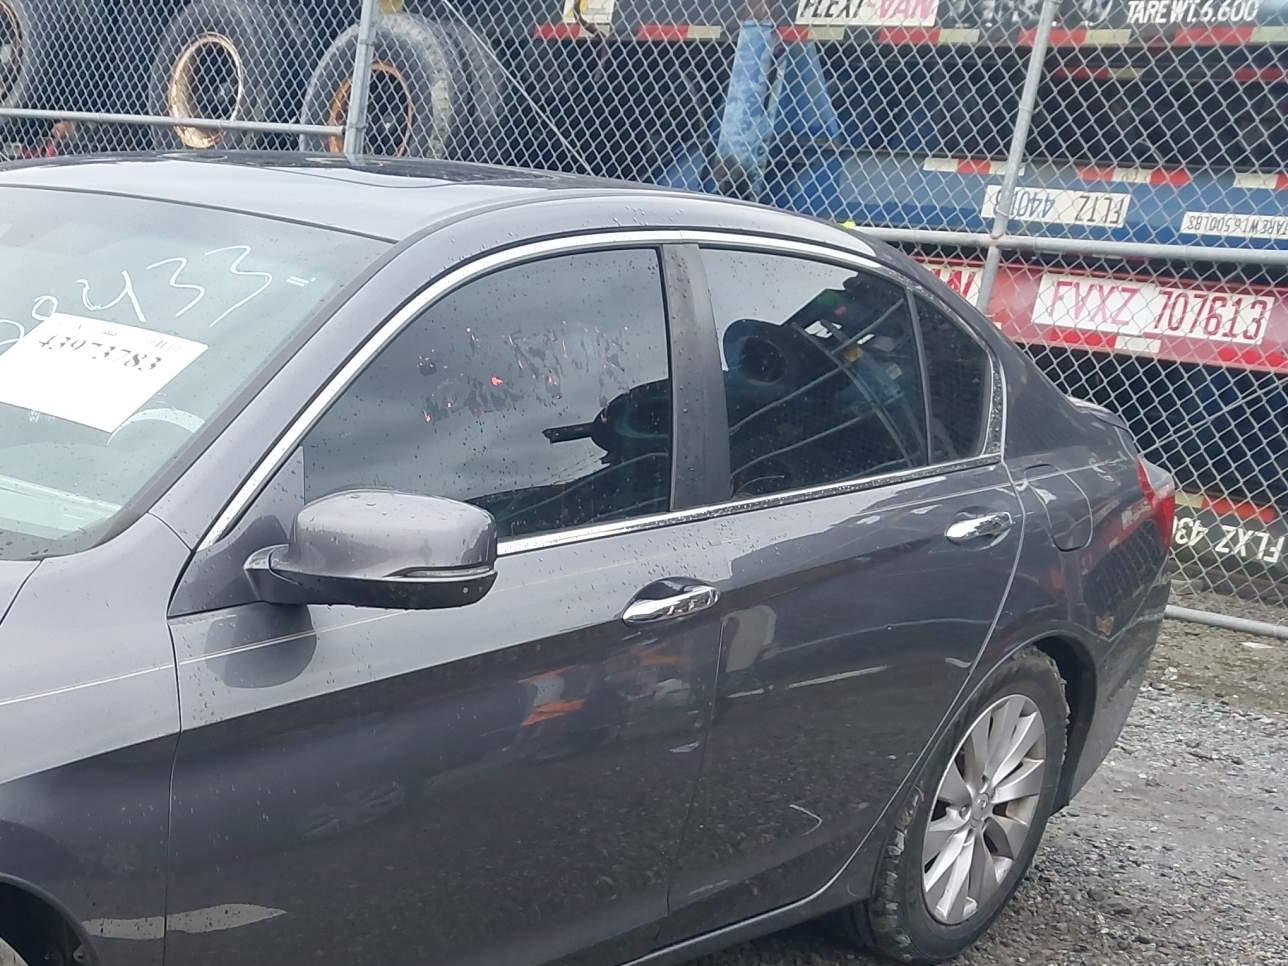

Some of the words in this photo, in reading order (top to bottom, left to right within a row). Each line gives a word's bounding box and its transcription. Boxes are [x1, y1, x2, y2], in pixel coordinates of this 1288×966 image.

[1075, 195, 1124, 224] FLTZ
[1048, 280, 1139, 326] FVXZ
[1153, 289, 1268, 340] 707613
[1215, 524, 1285, 563] FLXZ
